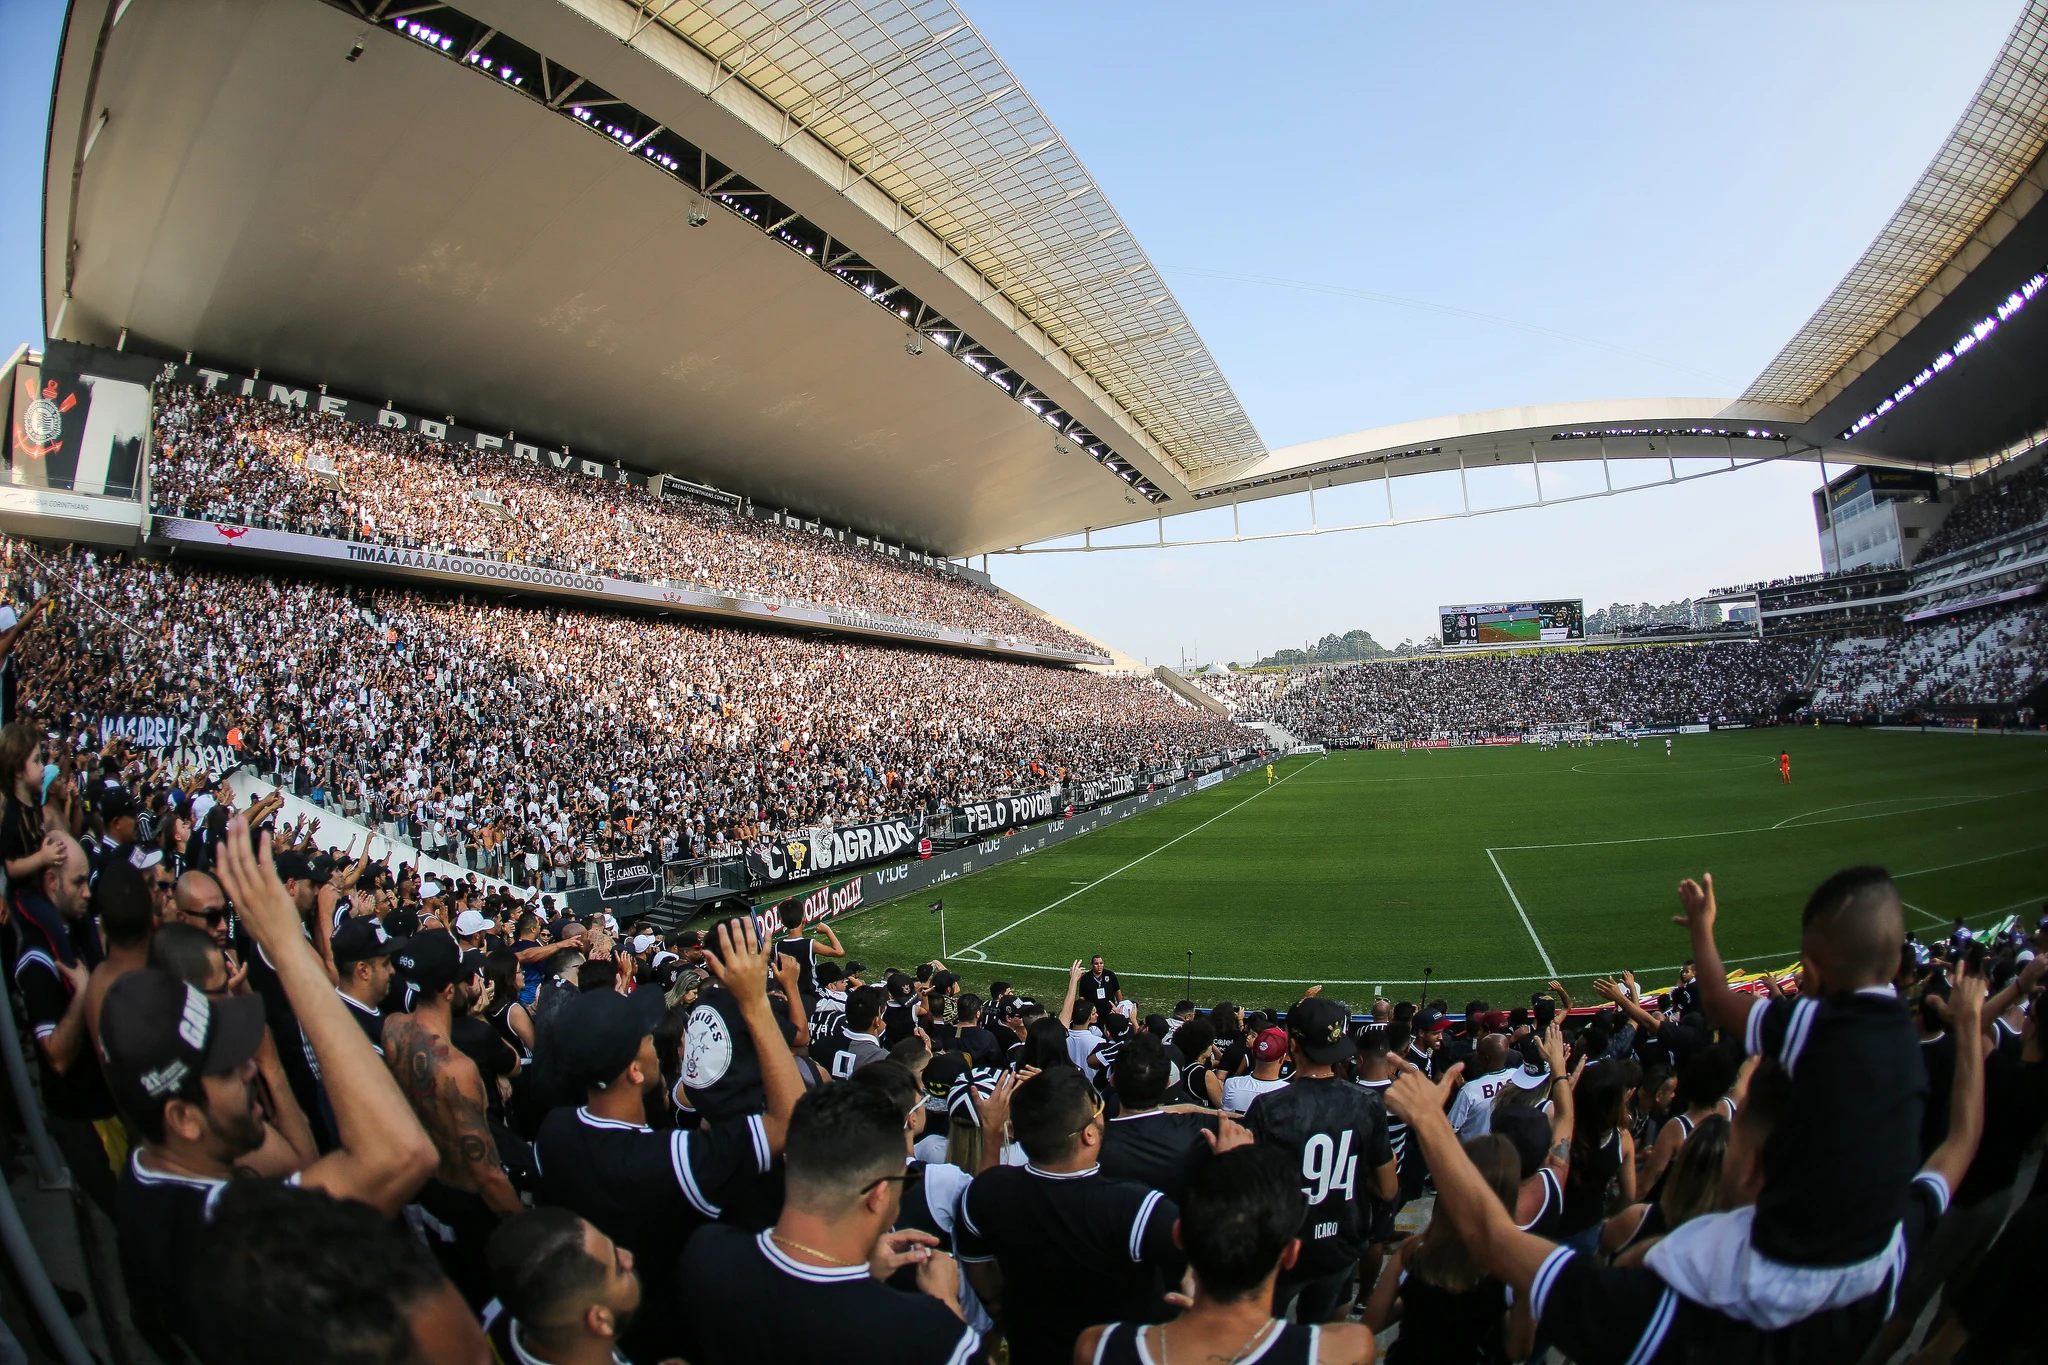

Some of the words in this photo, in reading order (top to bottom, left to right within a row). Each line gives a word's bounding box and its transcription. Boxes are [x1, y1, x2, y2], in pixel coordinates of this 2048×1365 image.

[197, 368, 348, 416] TIME
[378, 409, 447, 440] DO
[475, 432, 604, 478] POVO
[48, 499, 89, 512] CORINTHIANS
[856, 535, 900, 557] POR
[1470, 616, 1476, 626] 0
[1470, 628, 1477, 638] 0
[1412, 740, 1438, 748] ASKOV
[964, 803, 1006, 833] PELO
[1011, 793, 1045, 822] POVO
[804, 887, 831, 922] OLLY
[833, 876, 864, 917] DOLLY
[1301, 1129, 1358, 1205] 94
